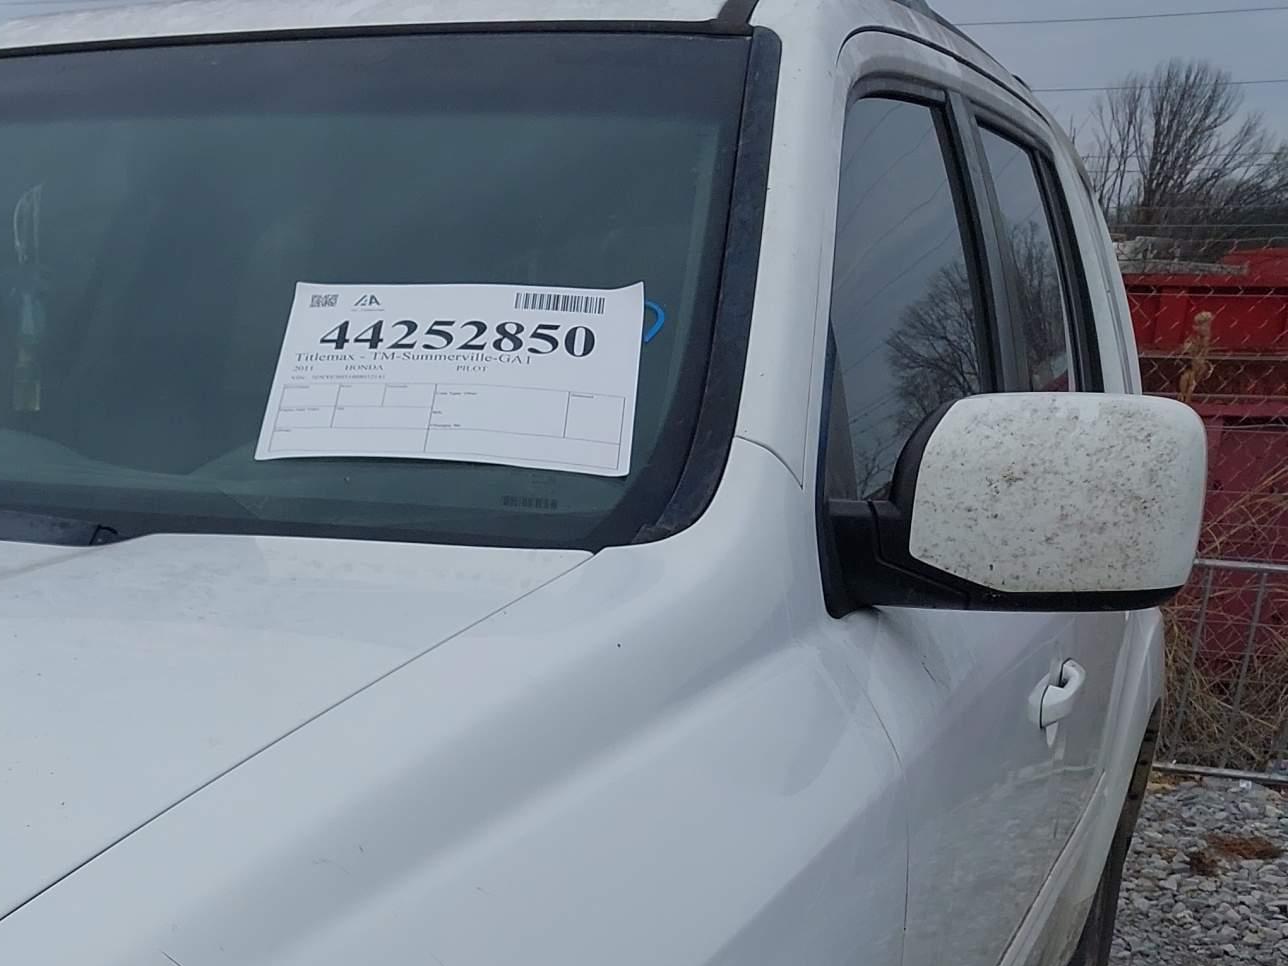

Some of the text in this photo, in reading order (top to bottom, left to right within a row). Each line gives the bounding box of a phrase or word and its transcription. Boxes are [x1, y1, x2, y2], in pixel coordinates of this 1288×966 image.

[319, 319, 596, 358] 44252850
[295, 352, 355, 362] Titlemax
[371, 351, 532, 365] TM-Summerville-GA1
